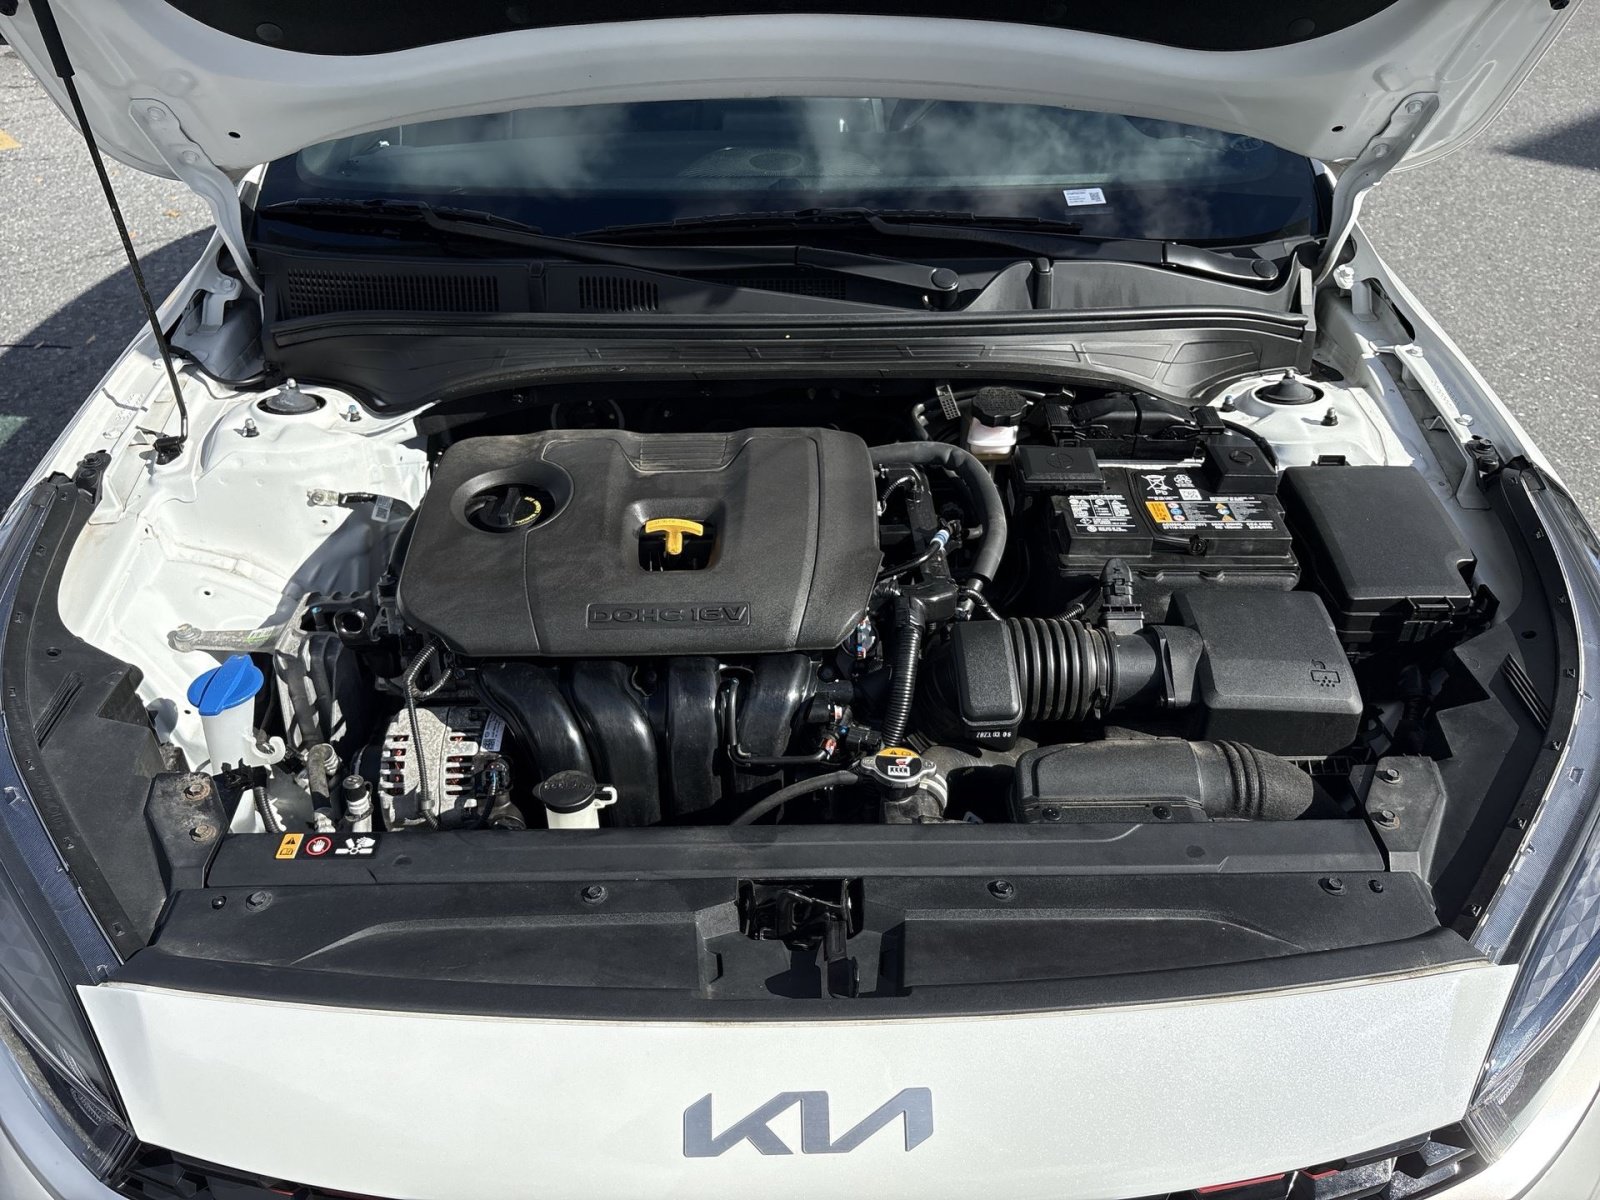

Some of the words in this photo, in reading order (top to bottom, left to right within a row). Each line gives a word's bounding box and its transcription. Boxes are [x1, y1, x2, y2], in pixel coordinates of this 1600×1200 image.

[589, 607, 683, 623] DOHC
[691, 606, 747, 622] 16V
[683, 1087, 934, 1157] KIA
